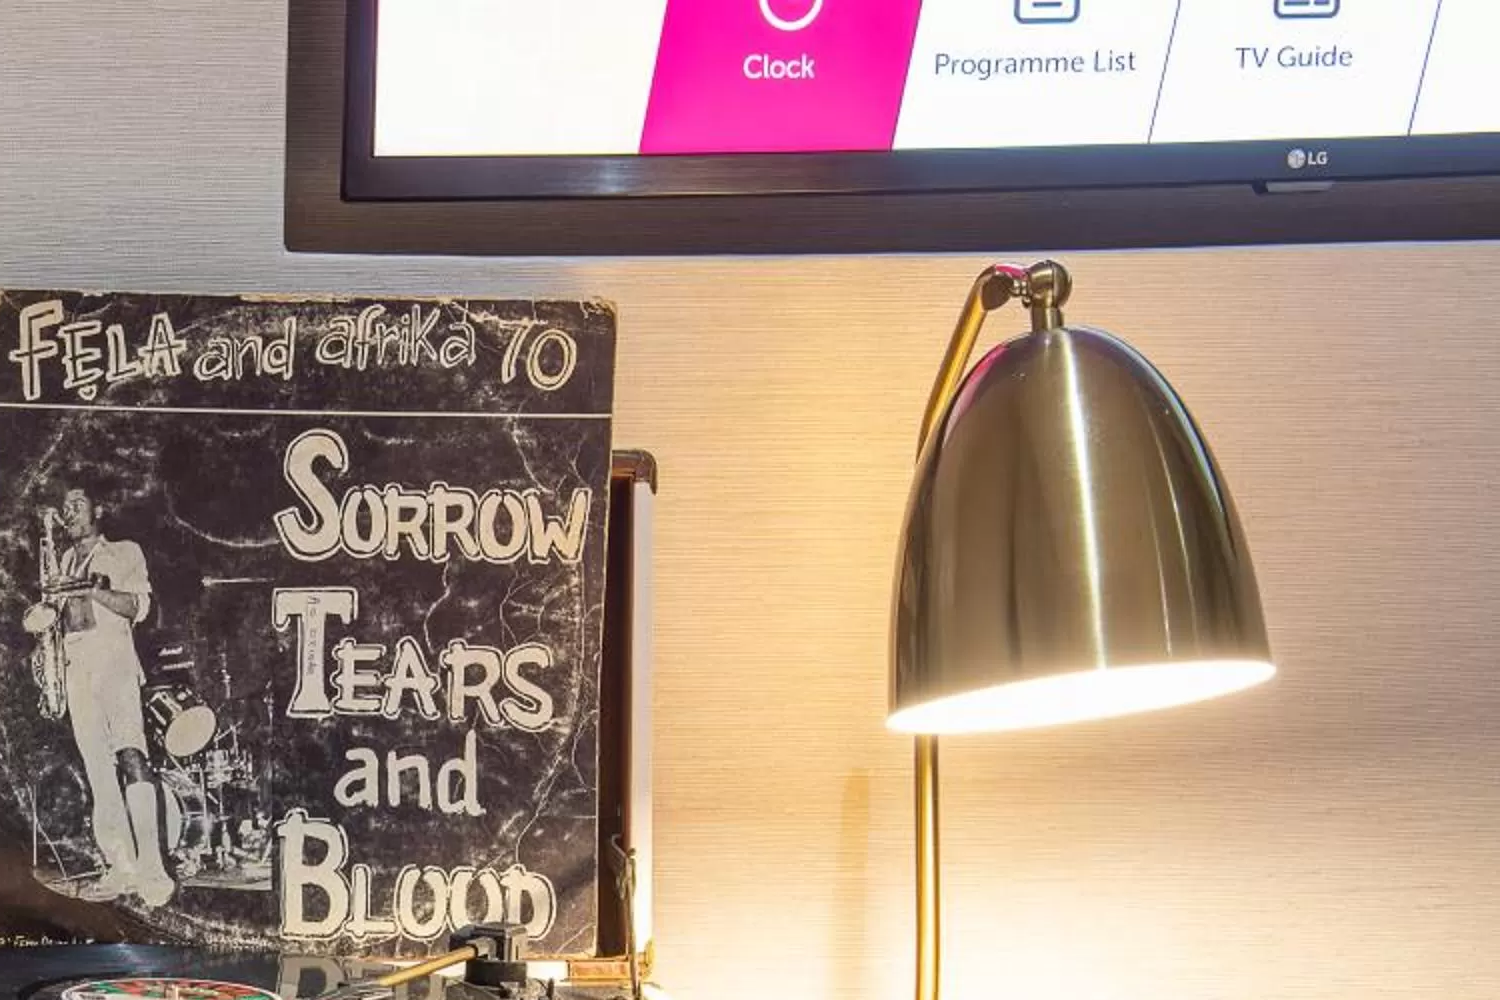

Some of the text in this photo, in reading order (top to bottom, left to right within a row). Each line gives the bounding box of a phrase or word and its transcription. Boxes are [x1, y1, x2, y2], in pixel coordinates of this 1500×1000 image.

[743, 53, 815, 79] Clock
[934, 49, 1136, 80] Programme List
[1235, 44, 1353, 69] TV Guide
[194, 316, 296, 381] and
[273, 428, 592, 564] SORROW
[272, 586, 555, 732] TEARS
[333, 729, 486, 817] and
